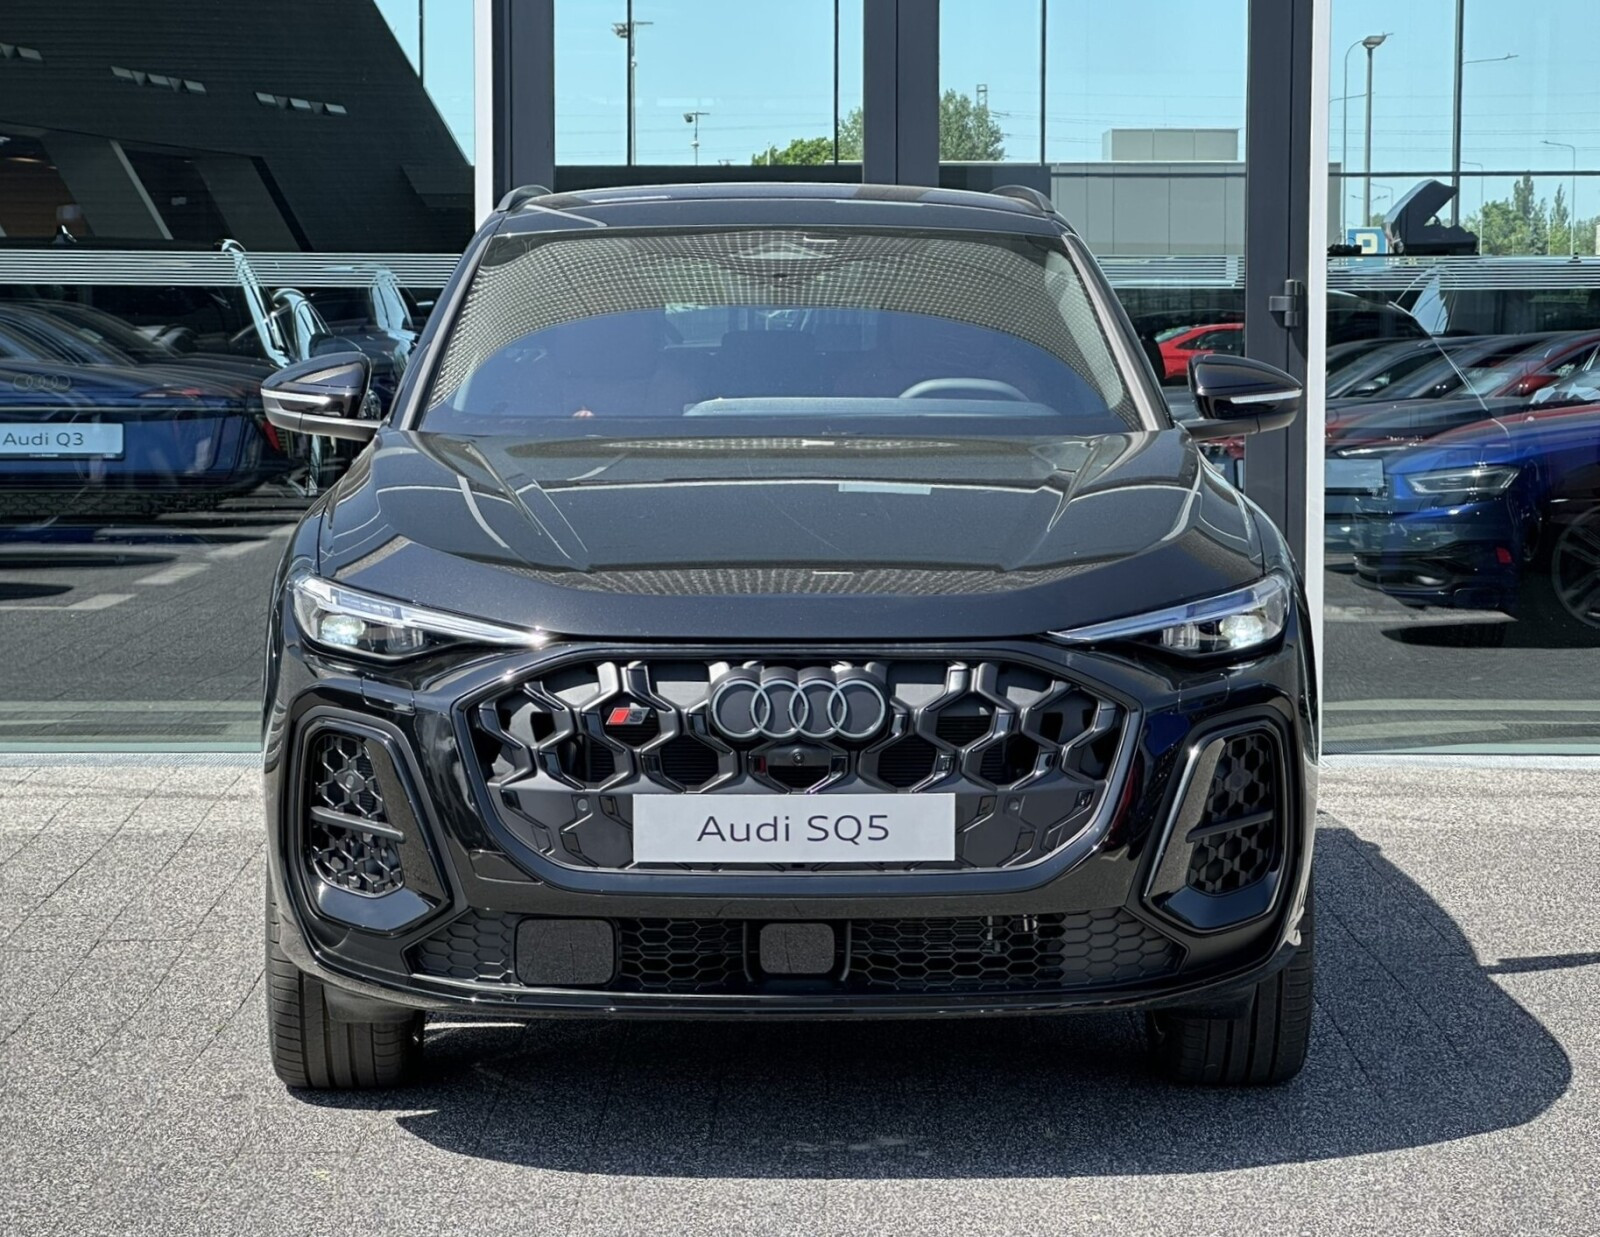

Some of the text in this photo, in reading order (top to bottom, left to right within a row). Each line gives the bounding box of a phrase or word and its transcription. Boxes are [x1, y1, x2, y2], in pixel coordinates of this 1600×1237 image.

[2, 432, 84, 447] Audi Q3
[696, 814, 890, 846] Audi SQ5
